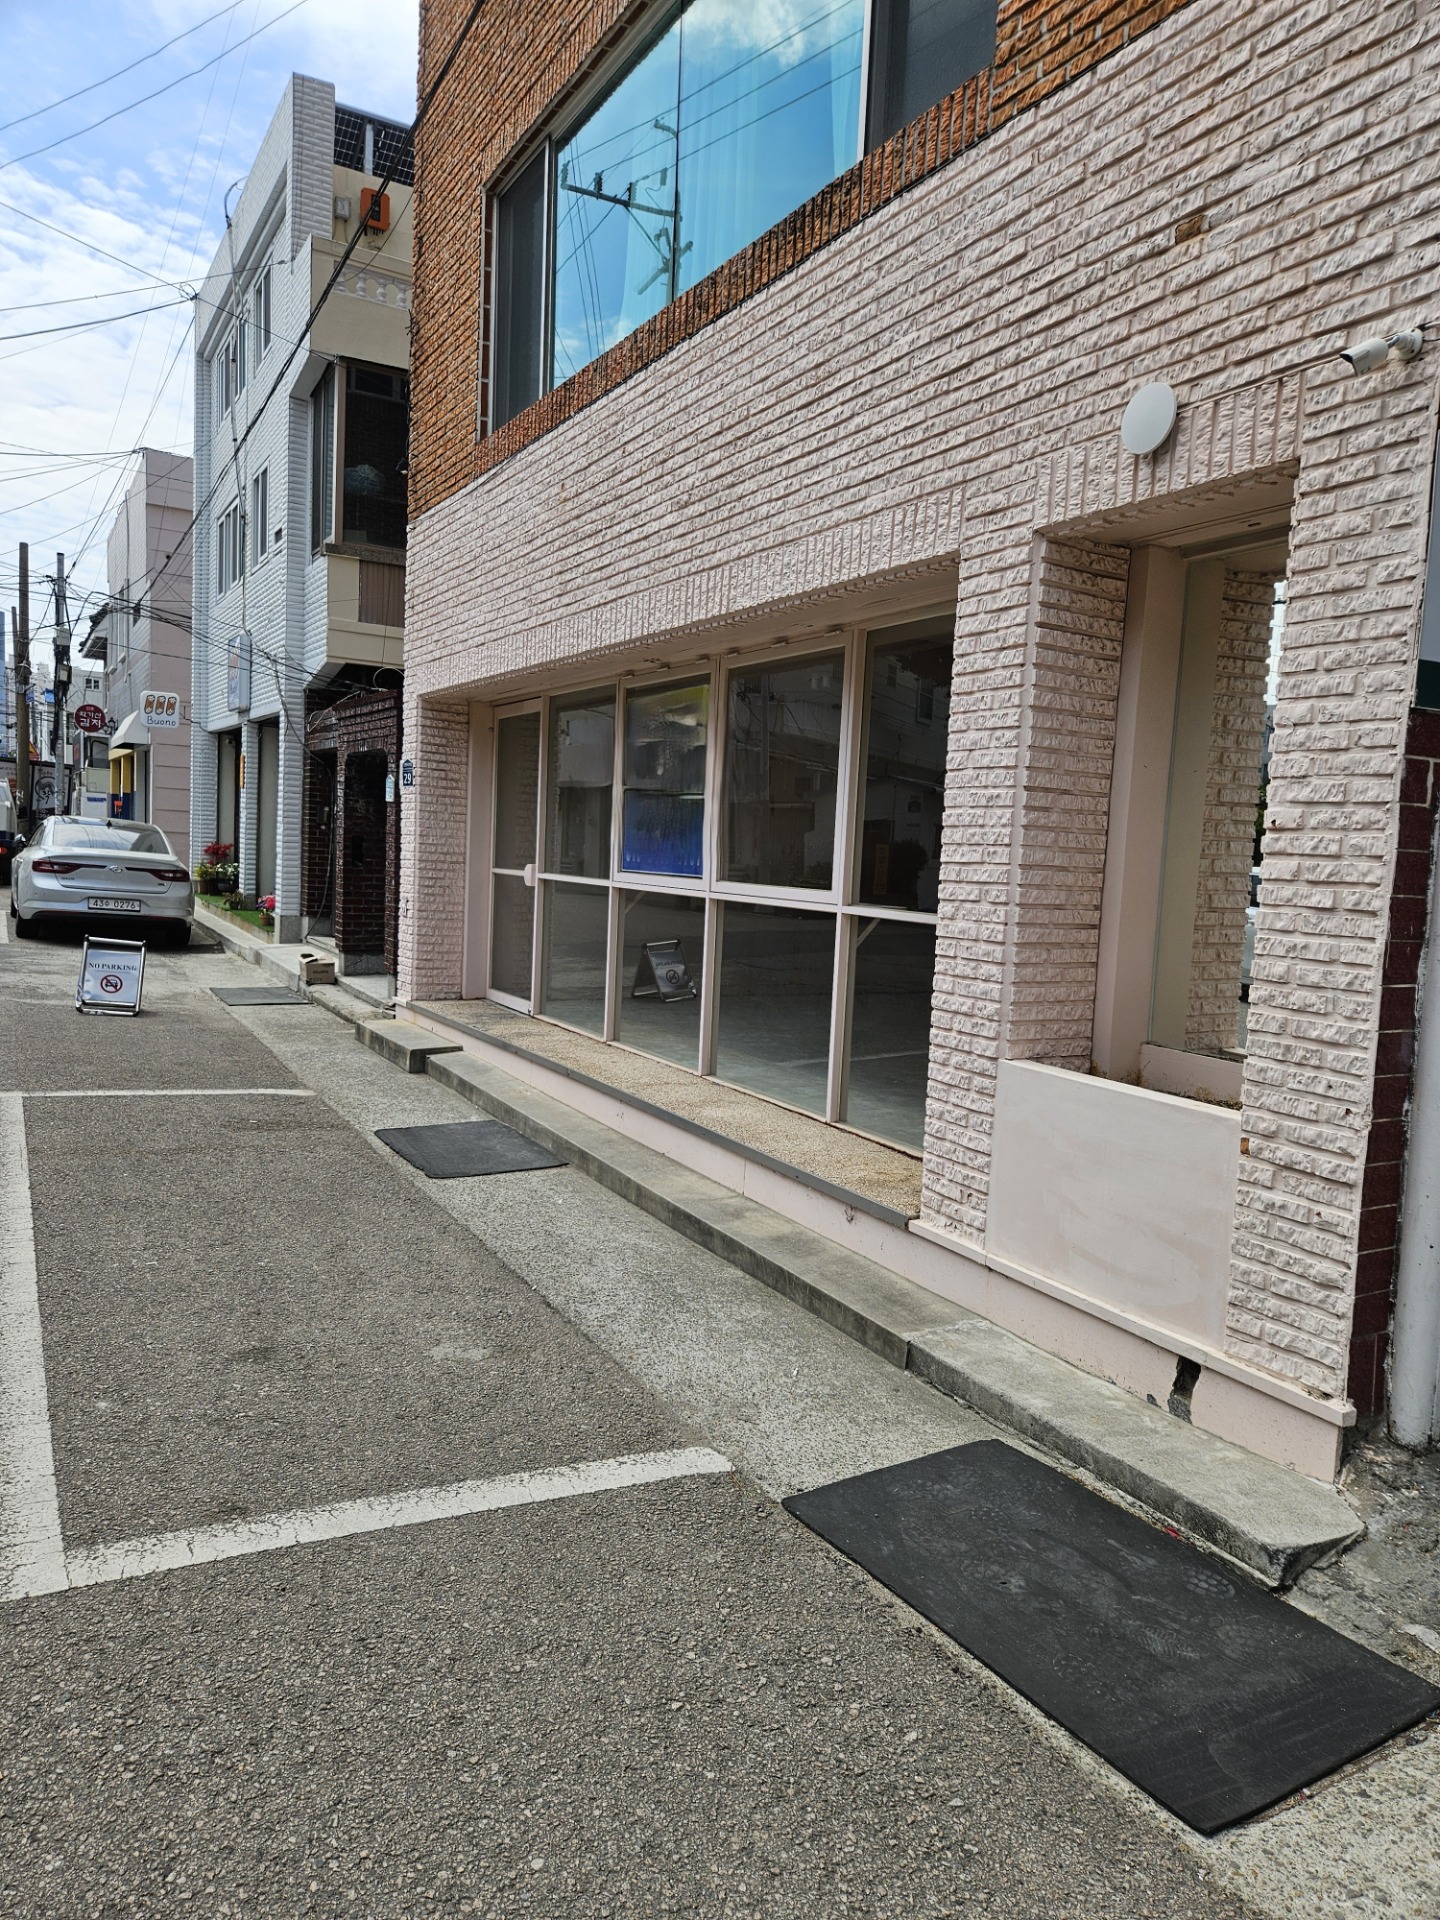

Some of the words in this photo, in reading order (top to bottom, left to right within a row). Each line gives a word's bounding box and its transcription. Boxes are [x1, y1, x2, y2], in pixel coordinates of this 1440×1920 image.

[147, 716, 176, 727] Buono
[404, 773, 412, 784] 29
[114, 900, 136, 909] 0276
[101, 963, 137, 971] PARKING
